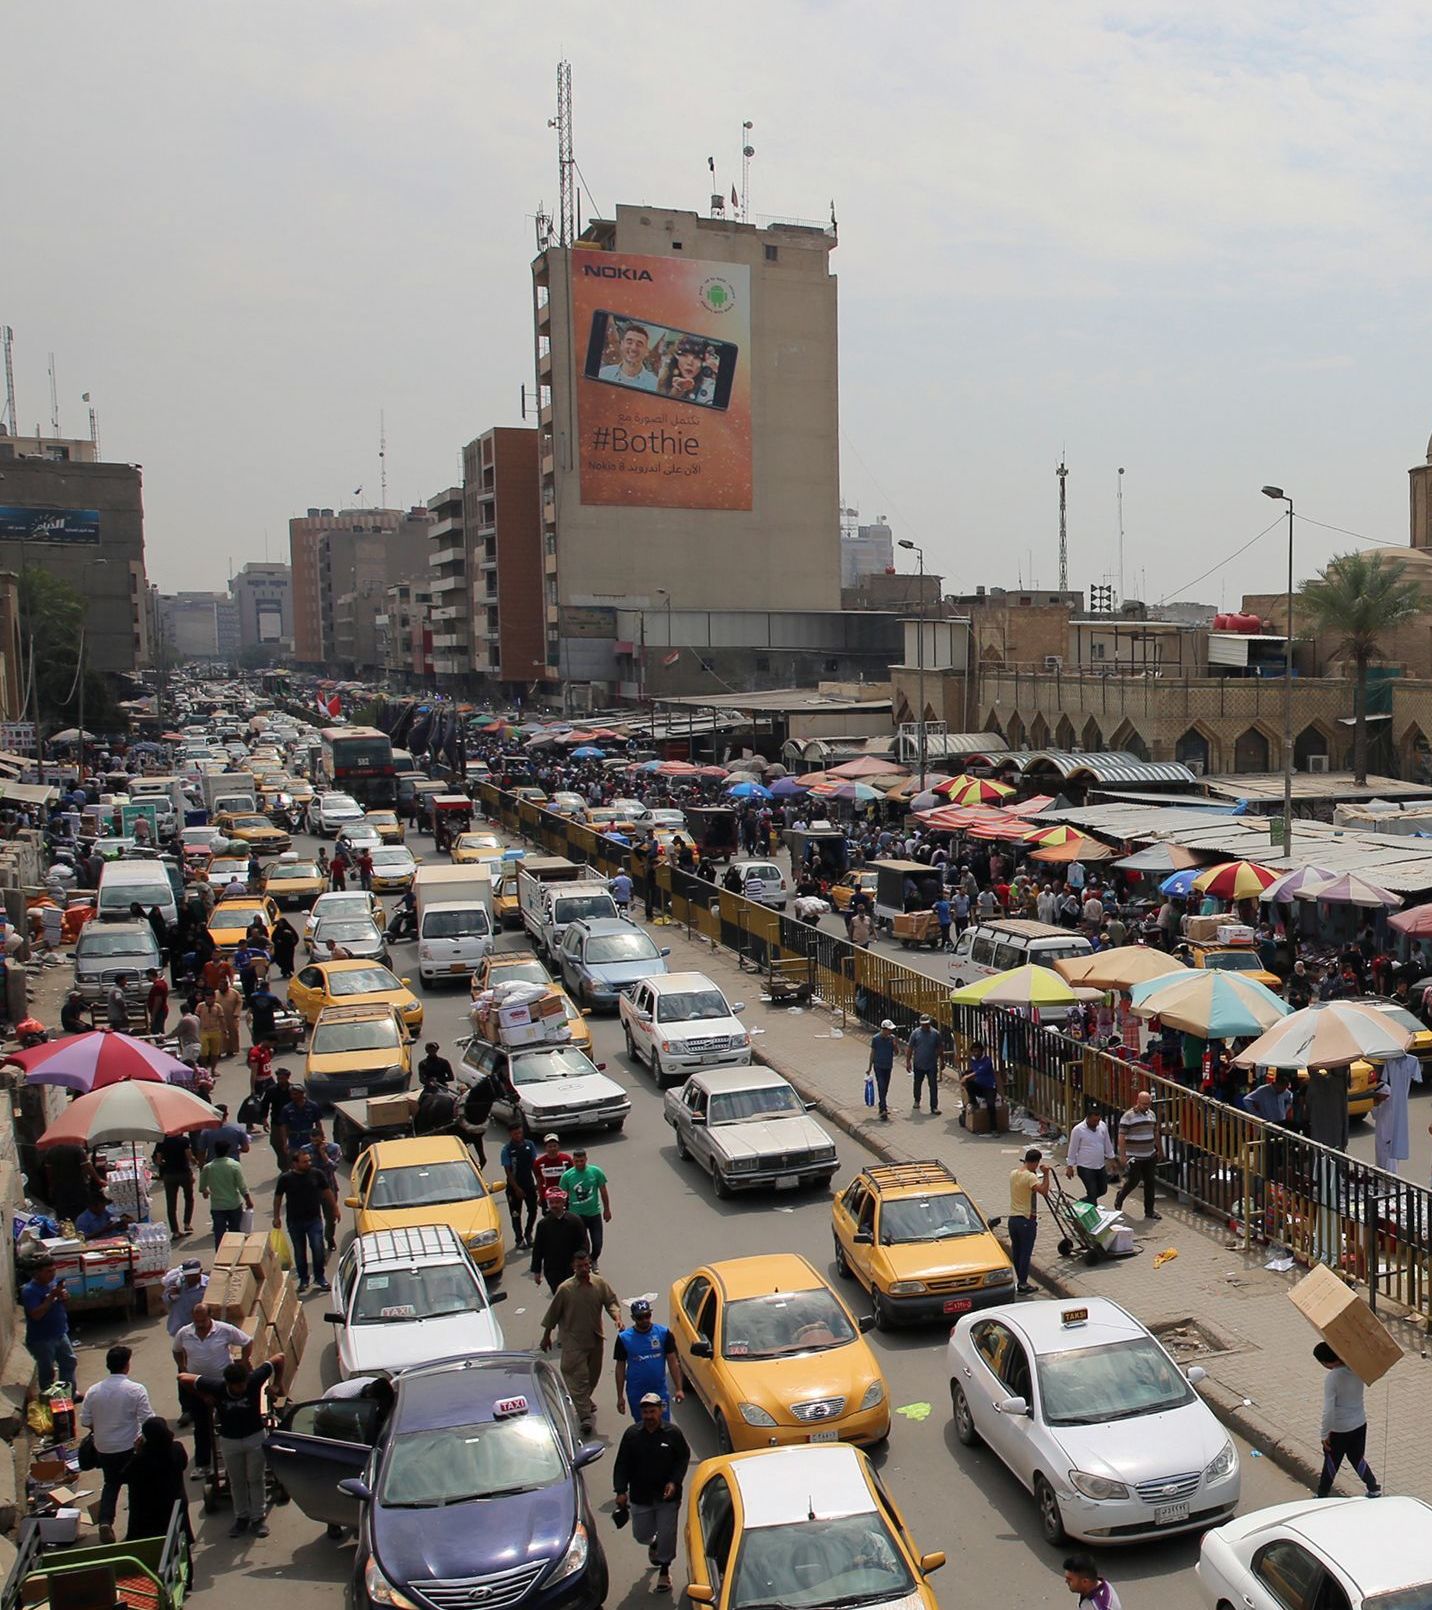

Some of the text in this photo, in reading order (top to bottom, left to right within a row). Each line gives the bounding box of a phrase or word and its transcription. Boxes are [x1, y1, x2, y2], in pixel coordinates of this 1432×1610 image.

[584, 264, 653, 282] NOKIA
[592, 426, 699, 456] #Bothie
[588, 461, 618, 471] Nokia
[1065, 1309, 1087, 1321] TAKSI
[501, 1399, 526, 1411] TAXI
